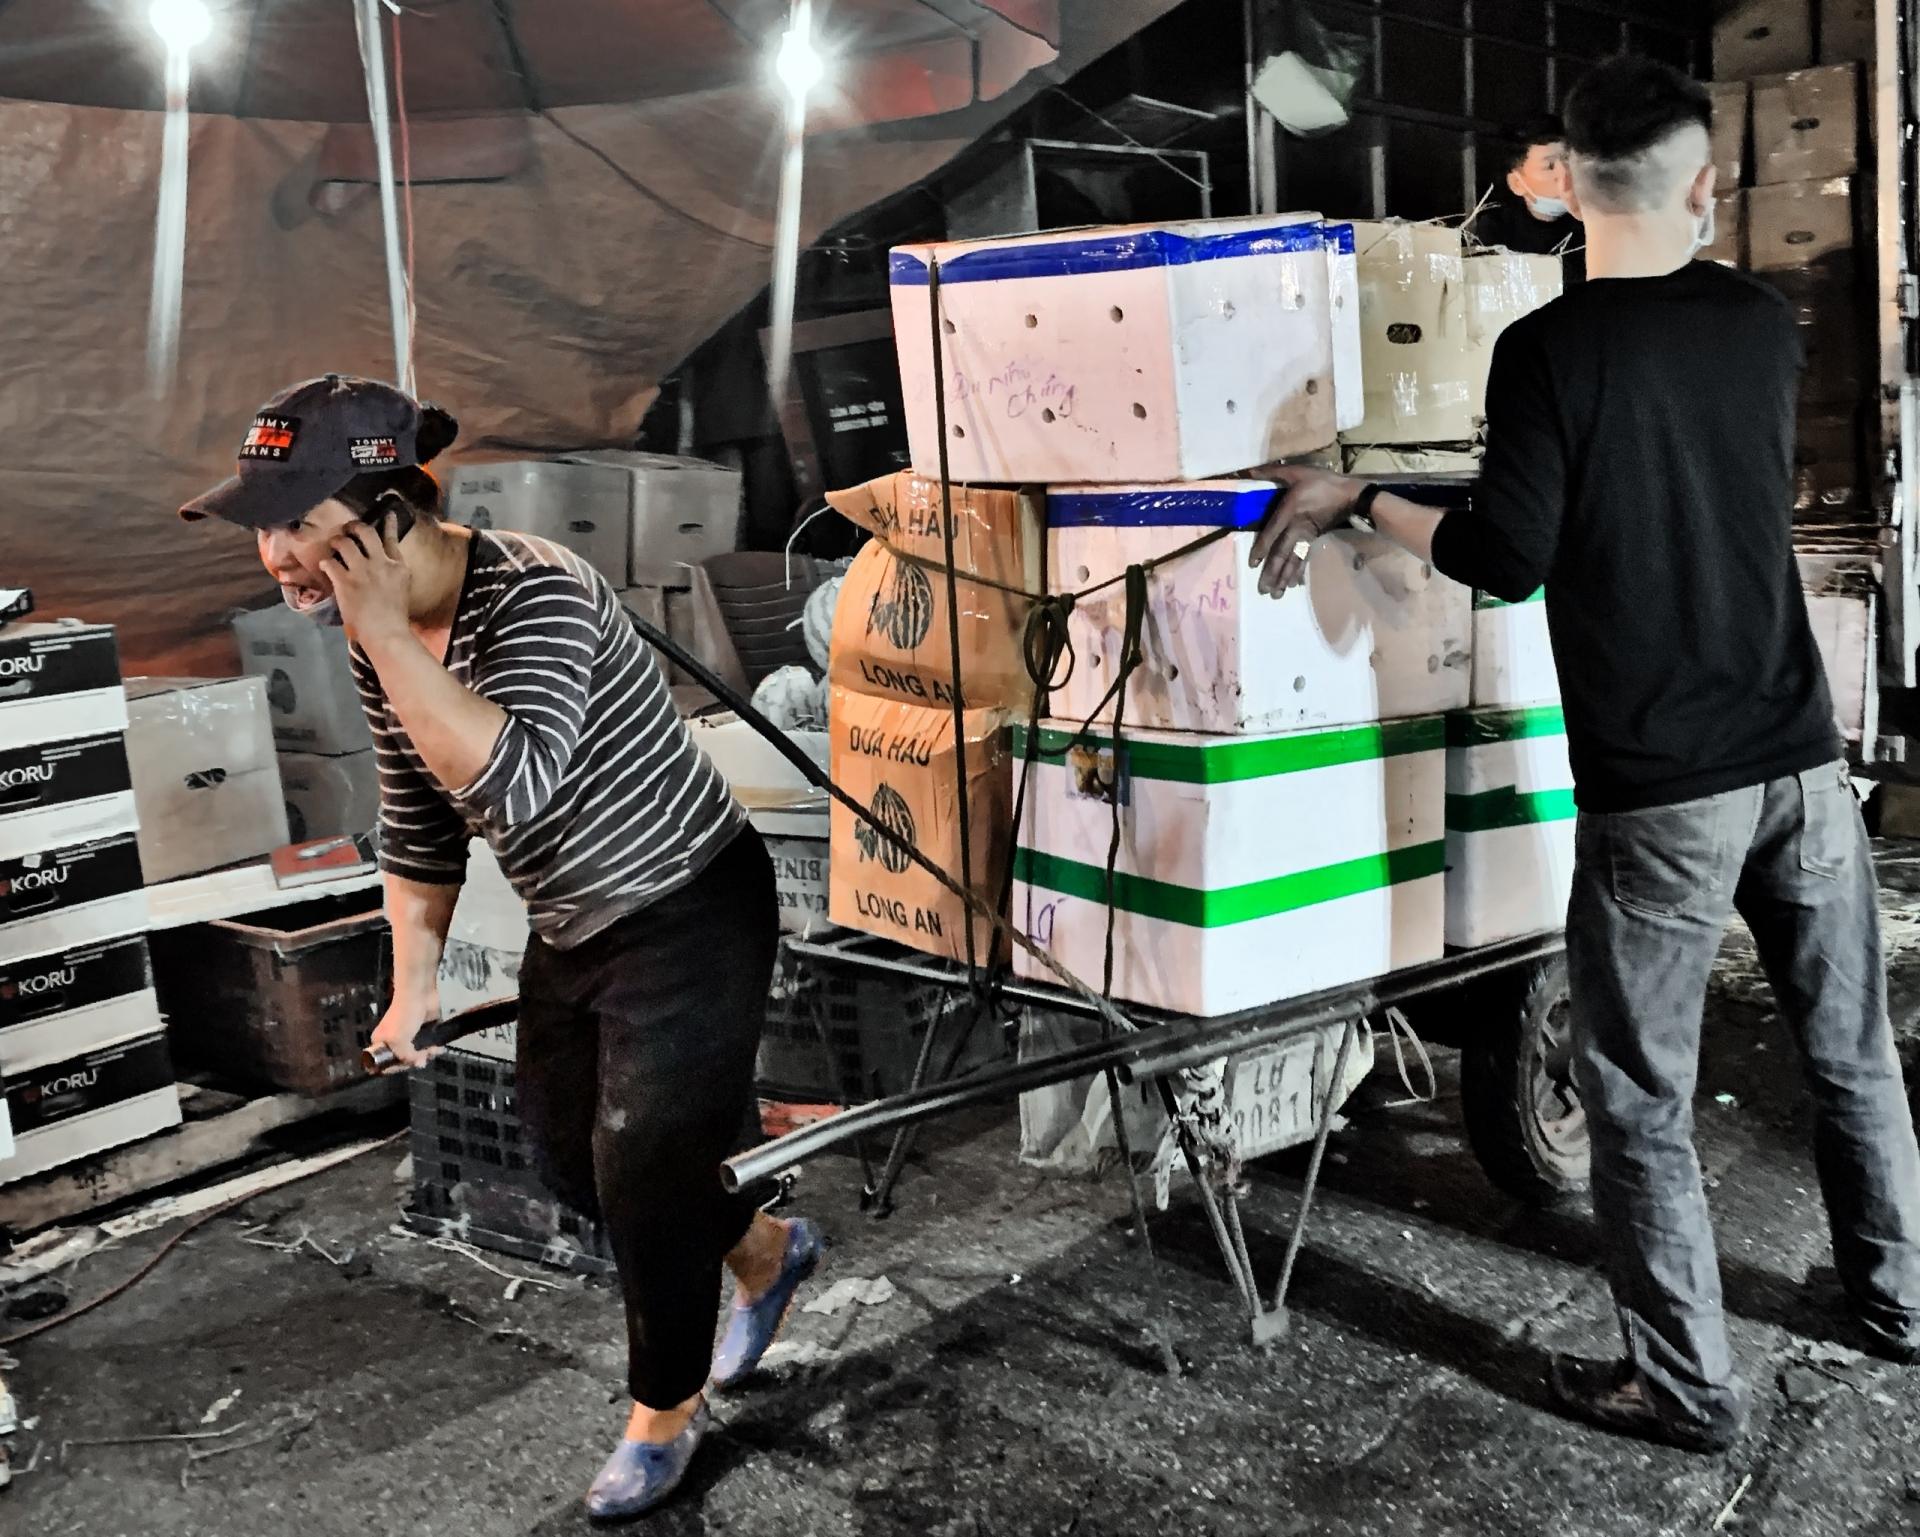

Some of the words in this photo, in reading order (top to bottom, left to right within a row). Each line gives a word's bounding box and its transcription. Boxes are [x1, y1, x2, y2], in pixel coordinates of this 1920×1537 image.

[355, 438, 393, 446] TOMMY
[859, 659, 927, 698] LONG
[10, 865, 70, 893] KORU
[855, 889, 909, 927] LONG
[915, 906, 943, 937] AN
[17, 966, 77, 996] KORU
[40, 1068, 99, 1097] KORU
